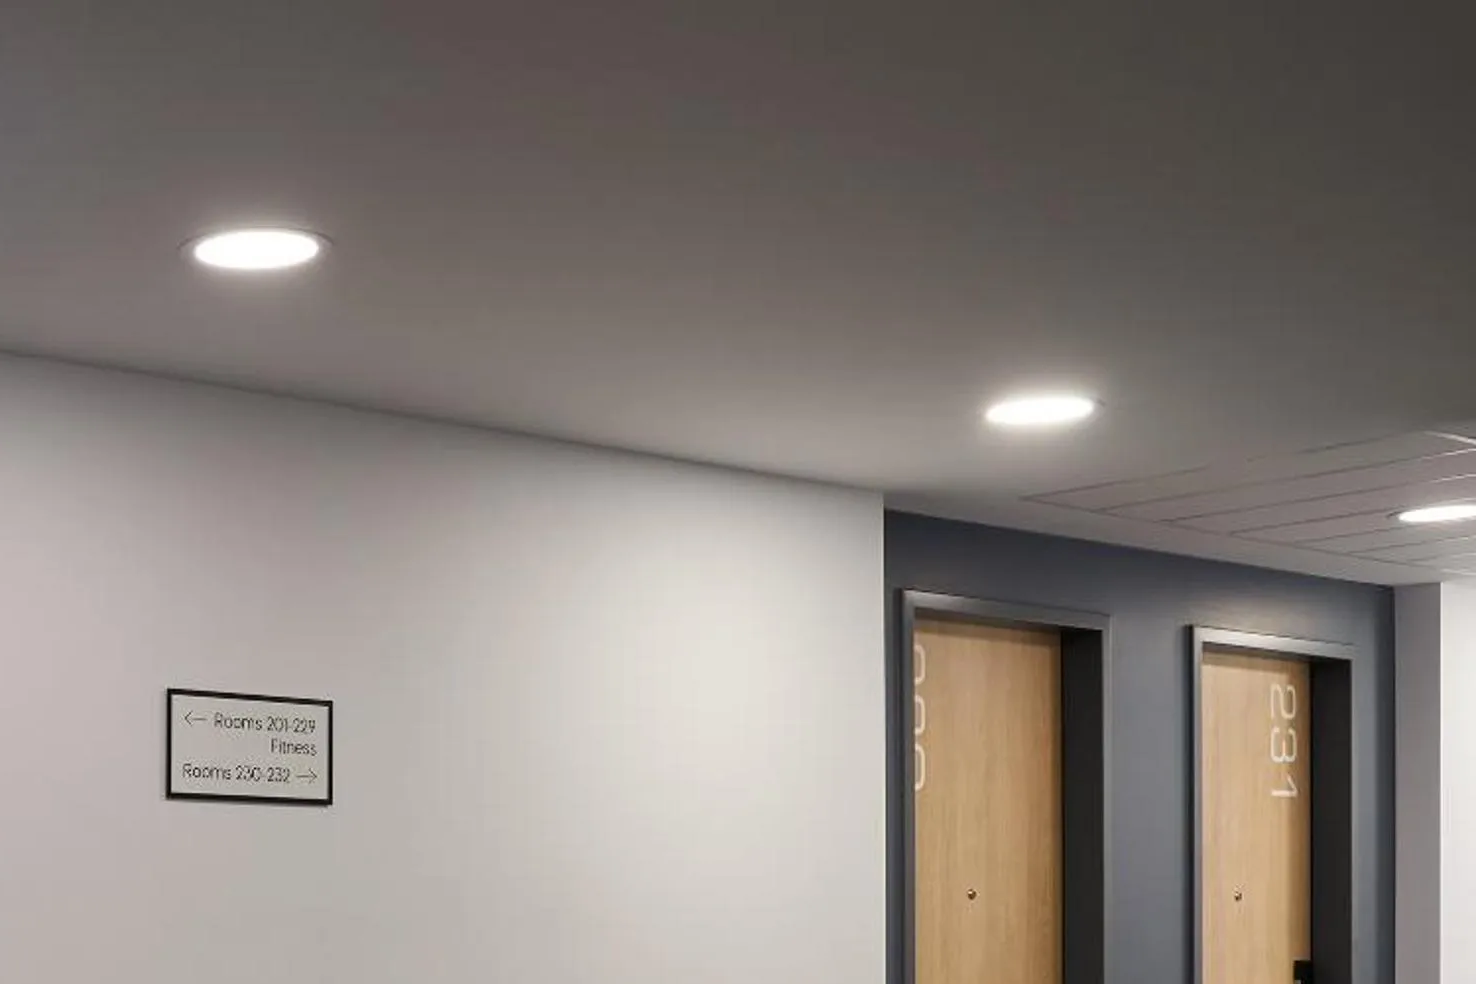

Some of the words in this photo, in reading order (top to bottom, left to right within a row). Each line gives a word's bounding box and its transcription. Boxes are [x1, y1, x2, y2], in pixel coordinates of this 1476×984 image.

[214, 711, 263, 732] Rooms
[267, 715, 316, 734] 201-229
[270, 737, 317, 757] Fitness
[1269, 682, 1300, 800] 231
[182, 763, 232, 781] Rooms
[235, 764, 291, 784] 230-232
